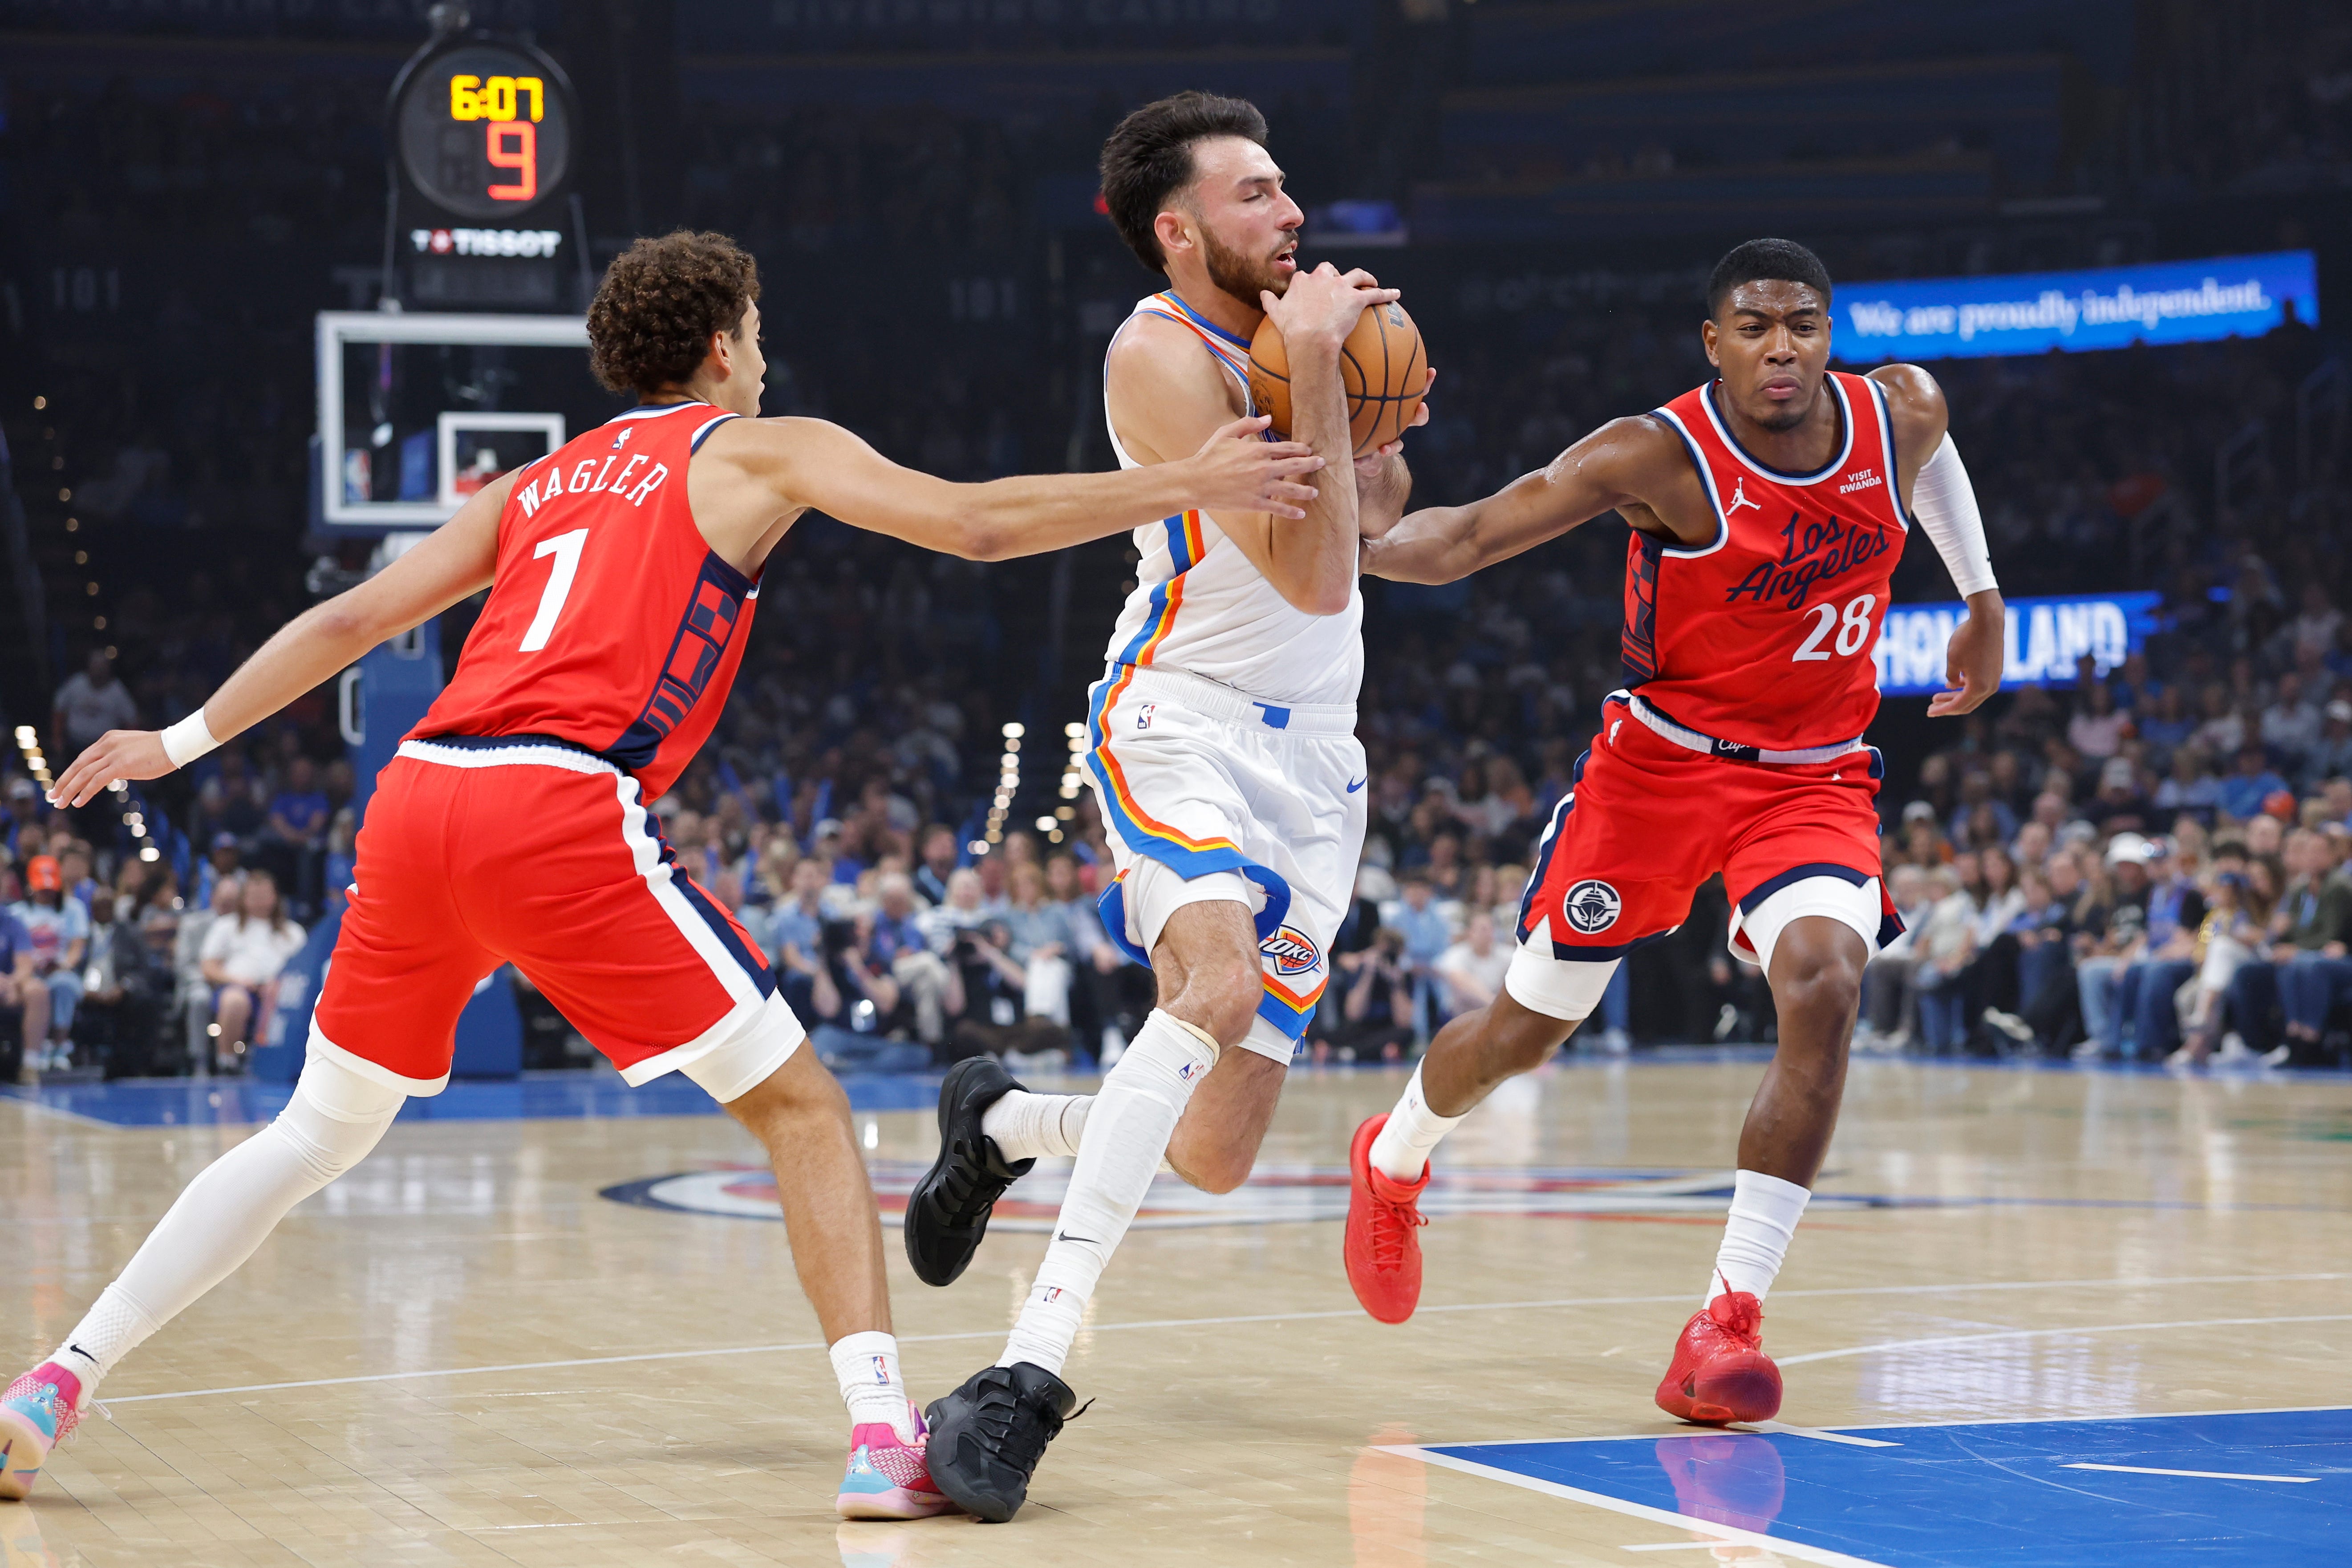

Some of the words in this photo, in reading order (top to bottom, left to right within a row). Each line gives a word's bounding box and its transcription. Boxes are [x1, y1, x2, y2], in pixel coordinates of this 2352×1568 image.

[450, 75, 543, 123] 6:07
[487, 121, 536, 201] 9
[1849, 300, 1904, 337] We
[1904, 304, 1957, 336] are
[1958, 289, 2082, 341] proudly
[517, 454, 669, 519] WAGLER
[1839, 476, 1882, 494] RWANDA
[1847, 469, 1872, 482] VISIT
[1725, 524, 1890, 610] Angeles
[1780, 511, 1846, 569] Los
[518, 528, 589, 652] 7
[1792, 593, 1877, 663] 28
[1262, 939, 1313, 961] OKC
